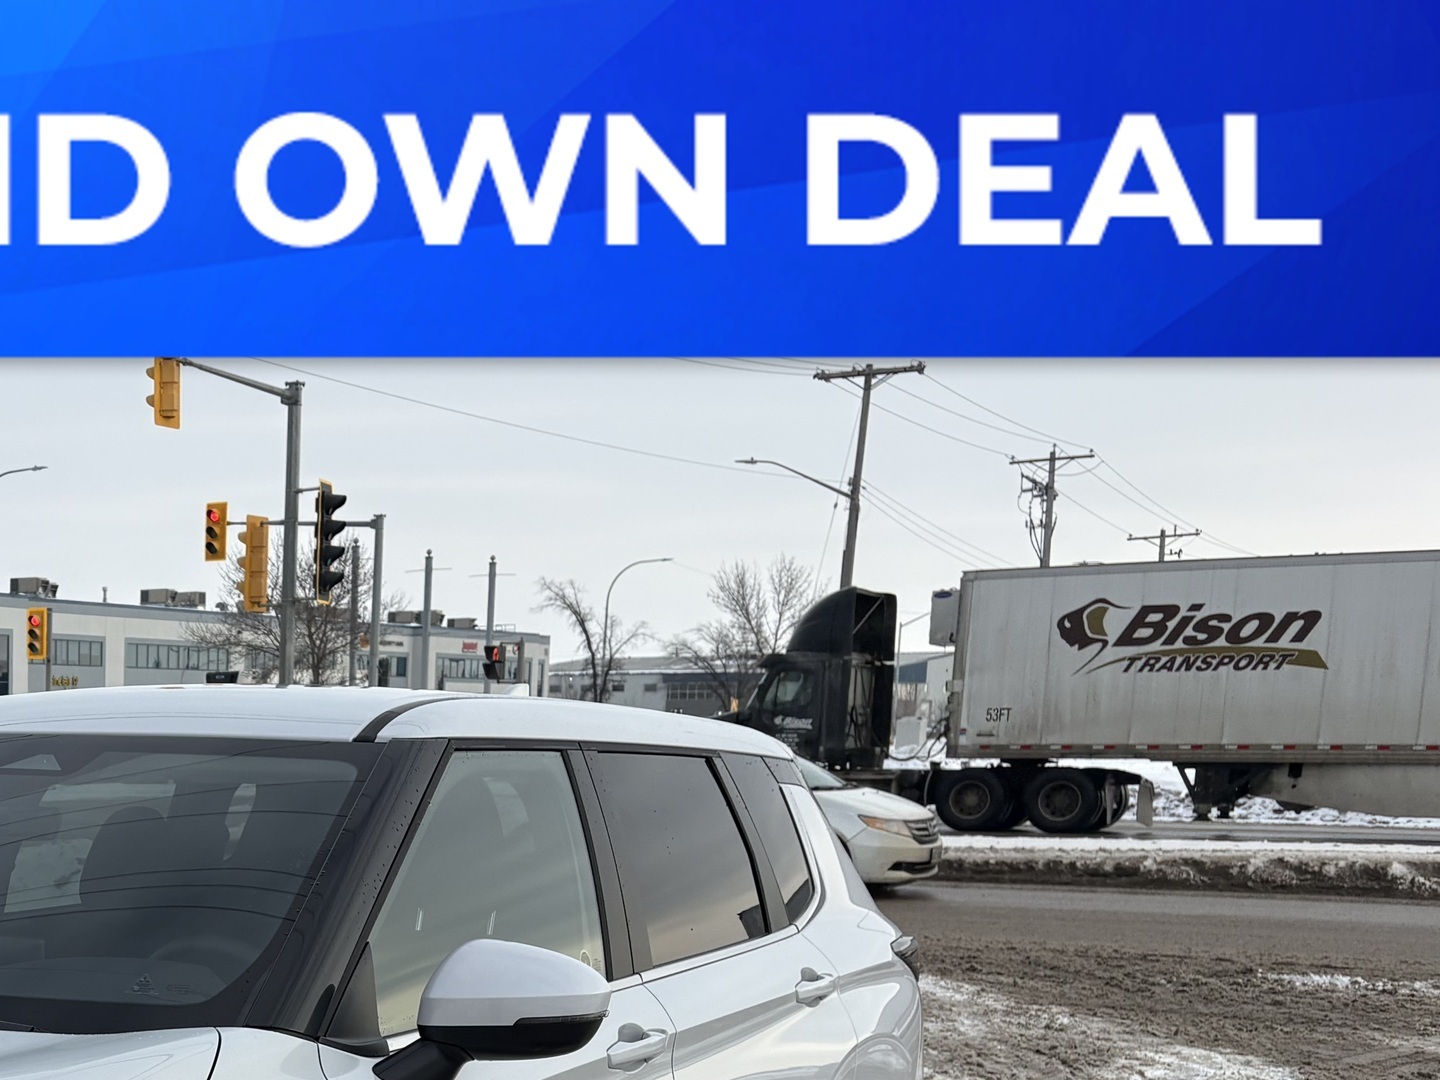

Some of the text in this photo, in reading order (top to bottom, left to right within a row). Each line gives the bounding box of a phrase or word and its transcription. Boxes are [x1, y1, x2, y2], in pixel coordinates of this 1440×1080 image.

[1111, 602, 1323, 648] Bison
[1122, 653, 1296, 673] TRANSPORT
[986, 707, 1013, 723] 53FT
